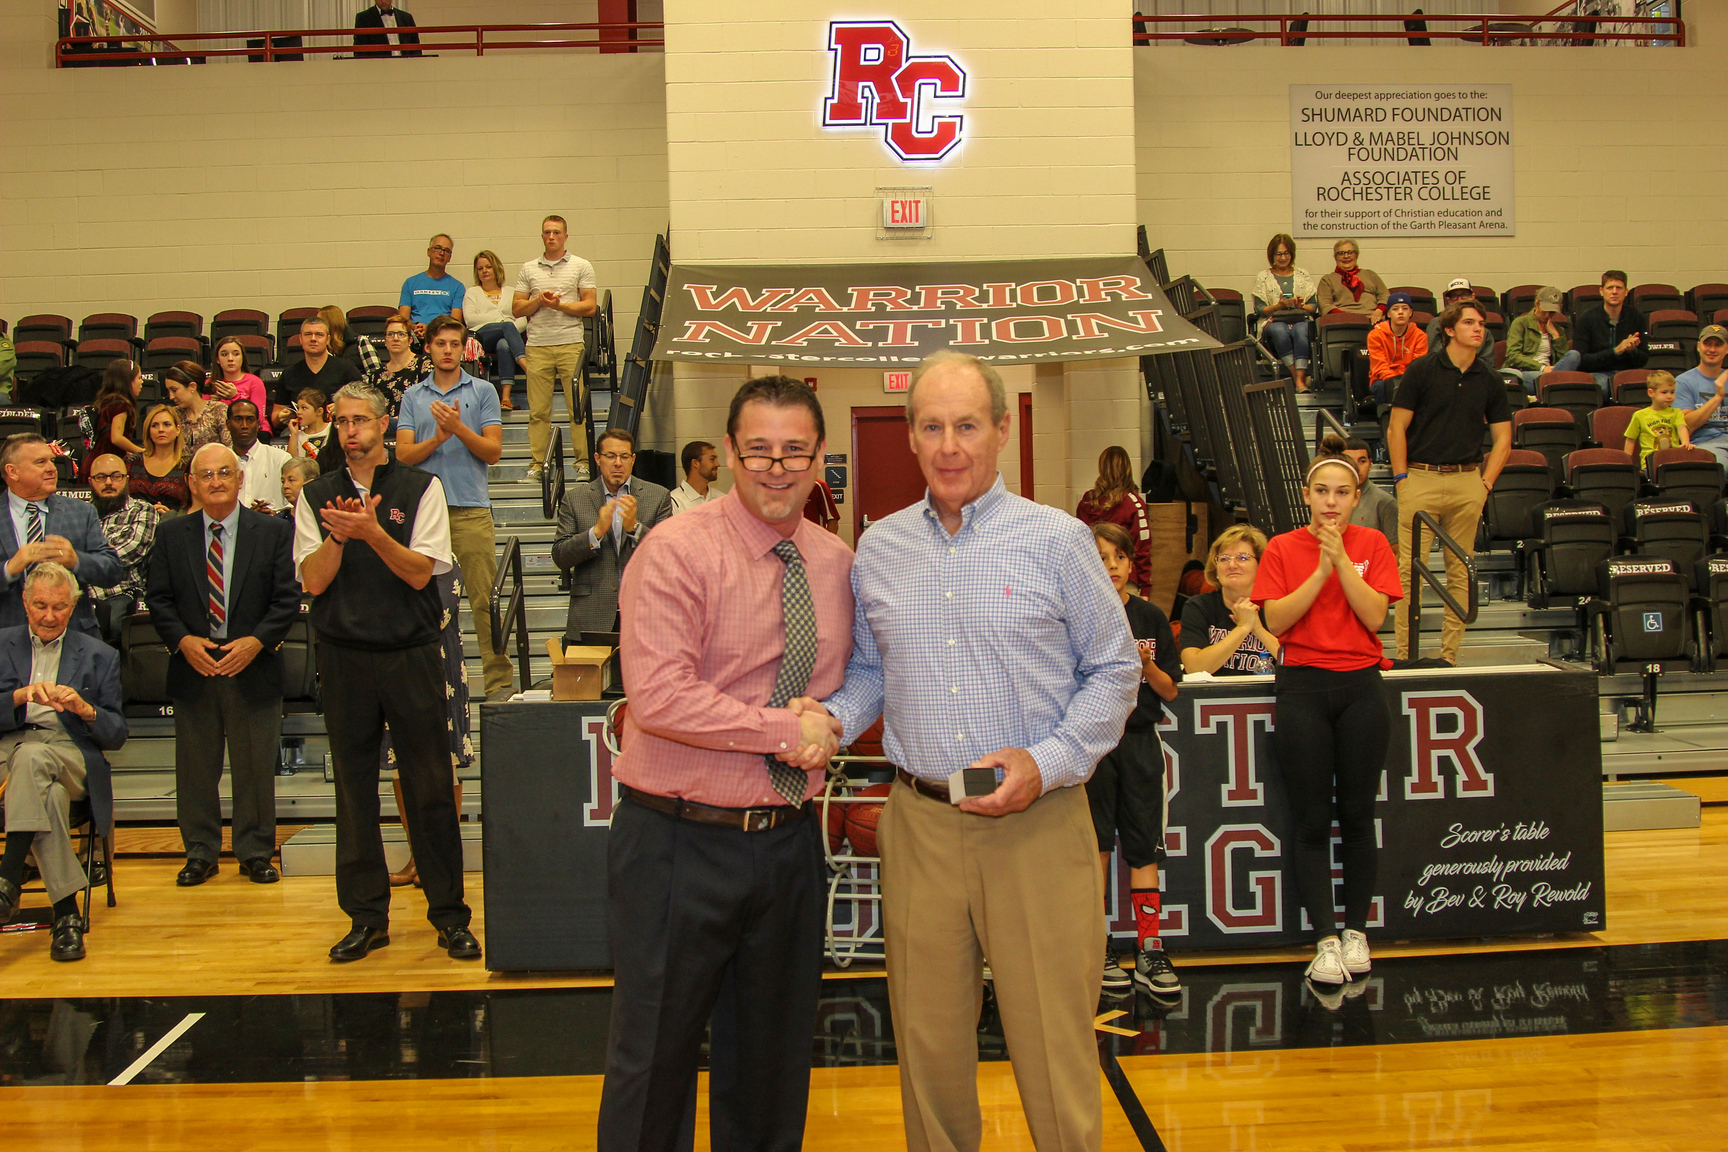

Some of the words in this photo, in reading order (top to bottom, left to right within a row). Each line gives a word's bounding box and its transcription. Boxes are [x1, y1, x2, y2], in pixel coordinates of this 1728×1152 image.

[823, 20, 966, 161] RC
[1315, 90, 1332, 100] Our
[1335, 90, 1371, 102] deepest
[1374, 90, 1431, 102] appreciation
[1434, 92, 1456, 102] goes
[1458, 91, 1468, 100] to
[1470, 90, 1488, 100] the:
[1301, 107, 1387, 122] SHUMARD
[1392, 107, 1502, 122] FOUNDATION
[1294, 131, 1348, 146] LLOYD
[1352, 131, 1364, 146] &
[1369, 131, 1426, 146] MABEL
[1429, 131, 1510, 146] JOHNSON
[1348, 147, 1458, 161] FOUNDATION
[1341, 170, 1440, 186] ASSOCIATES
[1444, 170, 1466, 185] OF
[1317, 186, 1413, 201] ROCHESTER
[1418, 186, 1491, 201] COLLEGE
[890, 199, 921, 224] EXIT
[1305, 209, 1318, 218] for
[1320, 208, 1341, 218] their
[1344, 209, 1380, 220] support
[1383, 208, 1393, 218] of
[1394, 208, 1435, 218] Christian
[1437, 208, 1482, 218] education
[1485, 207, 1503, 217] and
[1303, 221, 1318, 230] the
[1320, 221, 1378, 230] construction
[1381, 221, 1391, 230] of
[1392, 221, 1408, 230] the
[1410, 220, 1436, 230] Garth
[1438, 220, 1476, 230] Pleasant
[1479, 220, 1508, 230] Arena.
[683, 274, 1153, 312] WARRIOR
[672, 310, 1163, 347] NATION
[888, 373, 909, 390] EXIT
[56, 490, 92, 499] SAMUE
[390, 508, 405, 524] RC
[1612, 563, 1671, 575] RESERVED
[1646, 663, 1661, 673] 18
[158, 705, 174, 716] 16
[1441, 822, 1511, 849] Scorer's
[1513, 821, 1550, 841] table
[1418, 855, 1504, 887] generously
[1500, 851, 1571, 882] provided
[1404, 890, 1425, 917] by
[1425, 886, 1466, 915] Bev
[1468, 885, 1487, 908] &
[1492, 884, 1528, 913] Roy
[1531, 881, 1592, 908] Rewold
